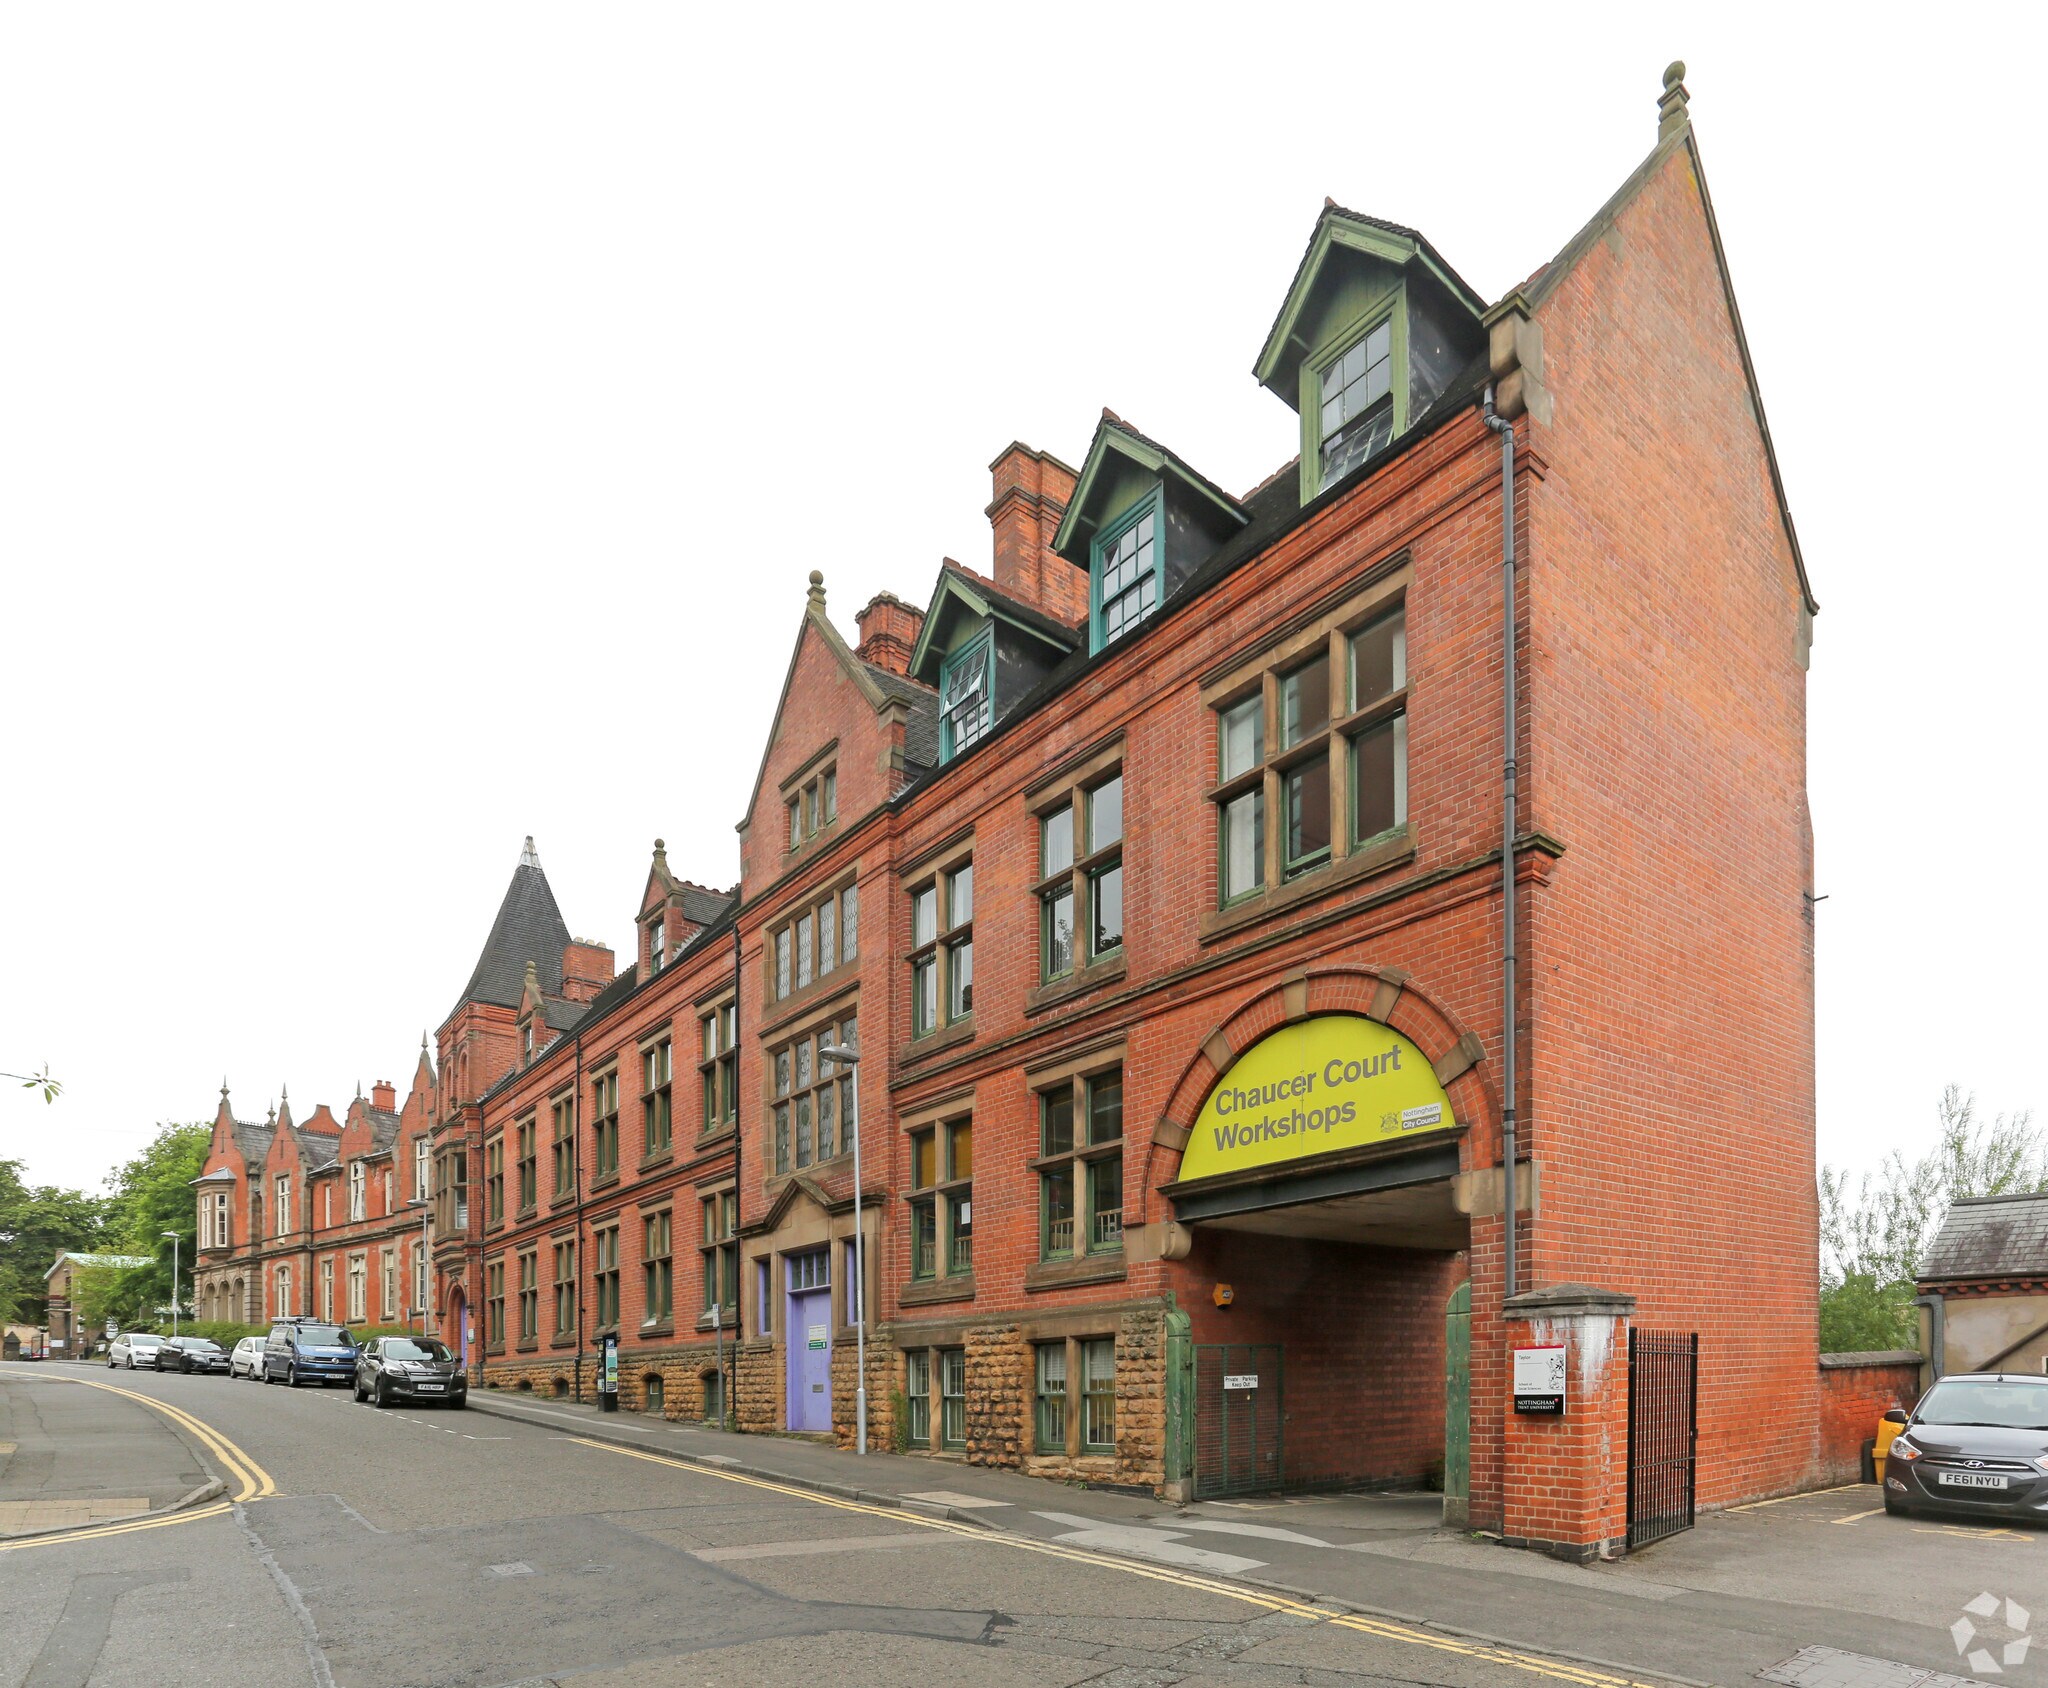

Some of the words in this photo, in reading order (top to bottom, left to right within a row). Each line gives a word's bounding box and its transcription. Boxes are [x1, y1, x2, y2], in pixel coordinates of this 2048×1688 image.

[1216, 1072, 1317, 1116] Chaucer
[1324, 1044, 1402, 1088] Court
[1403, 1105, 1439, 1118] Nottingham
[1213, 1101, 1356, 1151] Workshops
[1402, 1120, 1416, 1129] City
[1416, 1115, 1440, 1126] Council
[1946, 1474, 1973, 1485] FE61
[1976, 1476, 2000, 1487] NYU
